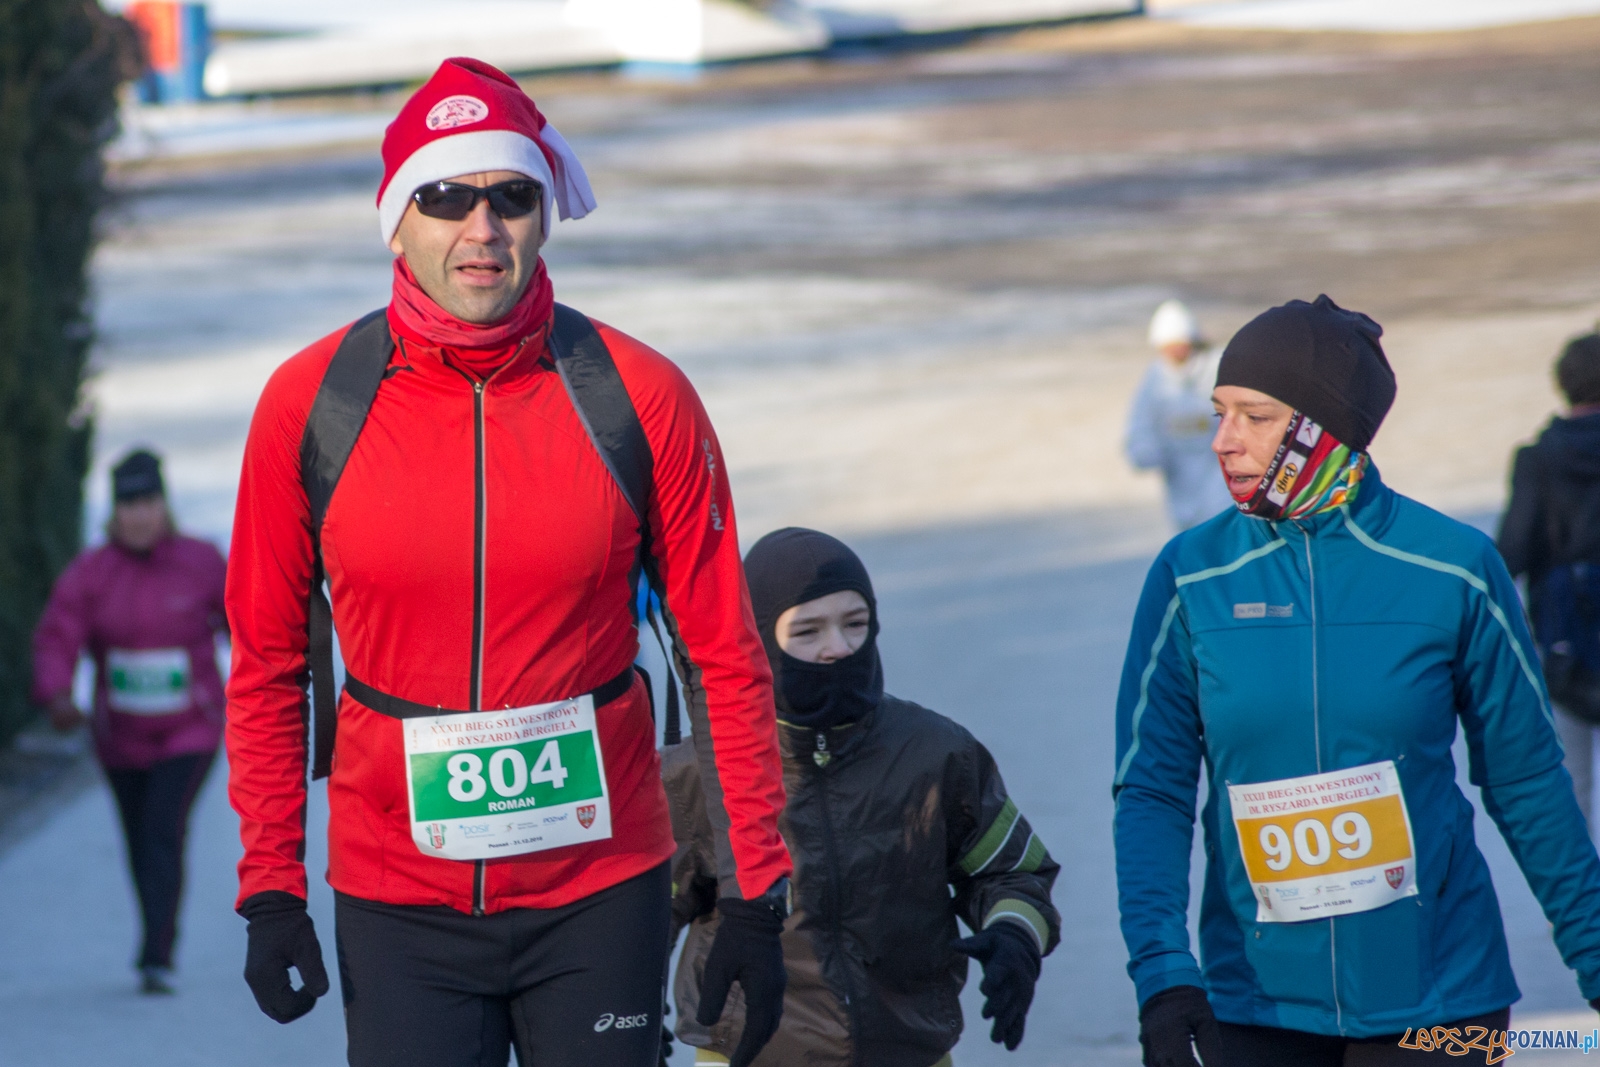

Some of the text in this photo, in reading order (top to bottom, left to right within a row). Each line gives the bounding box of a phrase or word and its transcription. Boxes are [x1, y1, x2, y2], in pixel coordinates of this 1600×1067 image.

[1277, 464, 1297, 492] Buff
[430, 705, 580, 736] XXXII BIEG SYLWESTROWY
[457, 730, 520, 746] RYSZARDA
[523, 720, 577, 738] BURGIELA
[447, 740, 568, 802] 804
[1268, 788, 1293, 800] BIEG
[1295, 771, 1382, 795] SYLWESTROWY
[488, 797, 535, 812] ROMAN
[1263, 798, 1319, 814] RYSZARDA
[1322, 785, 1381, 804] BURGIELA
[1259, 811, 1372, 872] 909
[615, 1013, 648, 1028] asics
